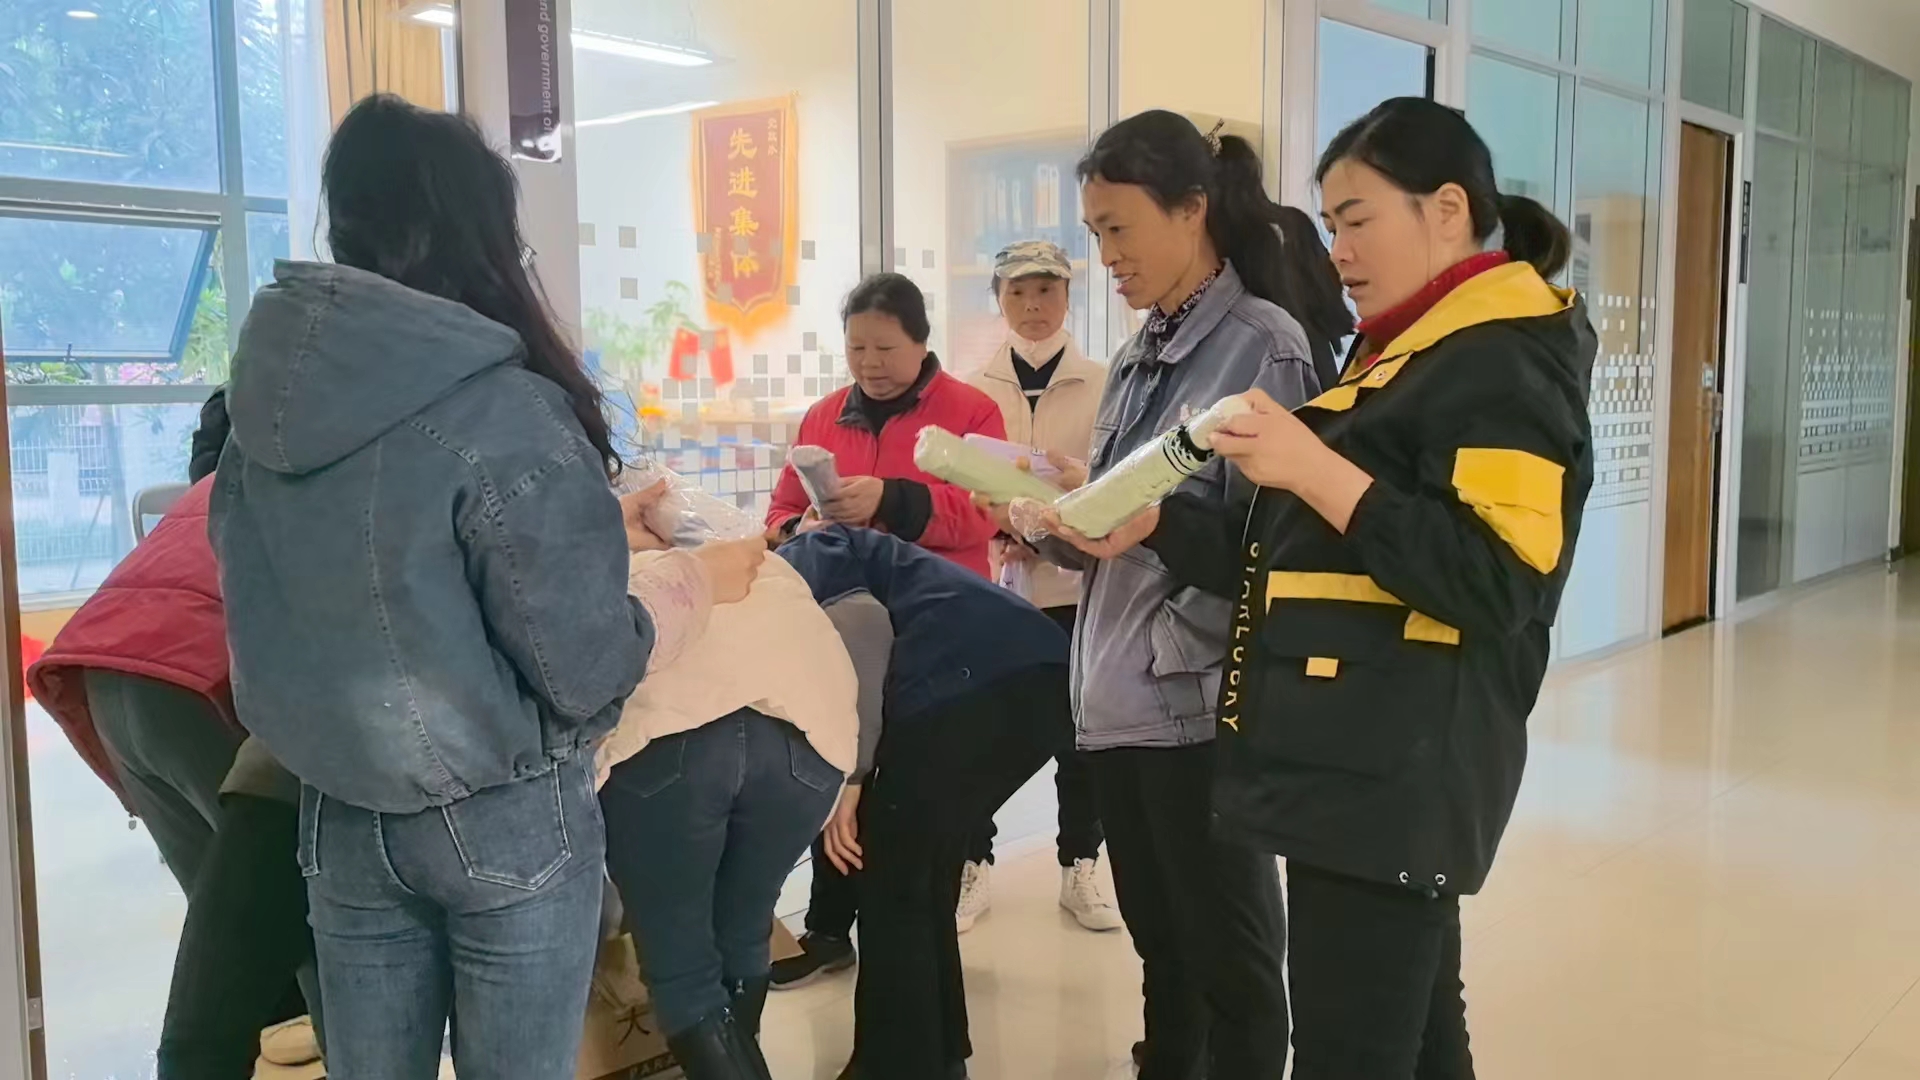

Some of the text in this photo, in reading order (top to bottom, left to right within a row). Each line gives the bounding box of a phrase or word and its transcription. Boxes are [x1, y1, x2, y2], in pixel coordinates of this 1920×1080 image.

[537, 24, 553, 115] government
[727, 127, 761, 279] 先进集体
